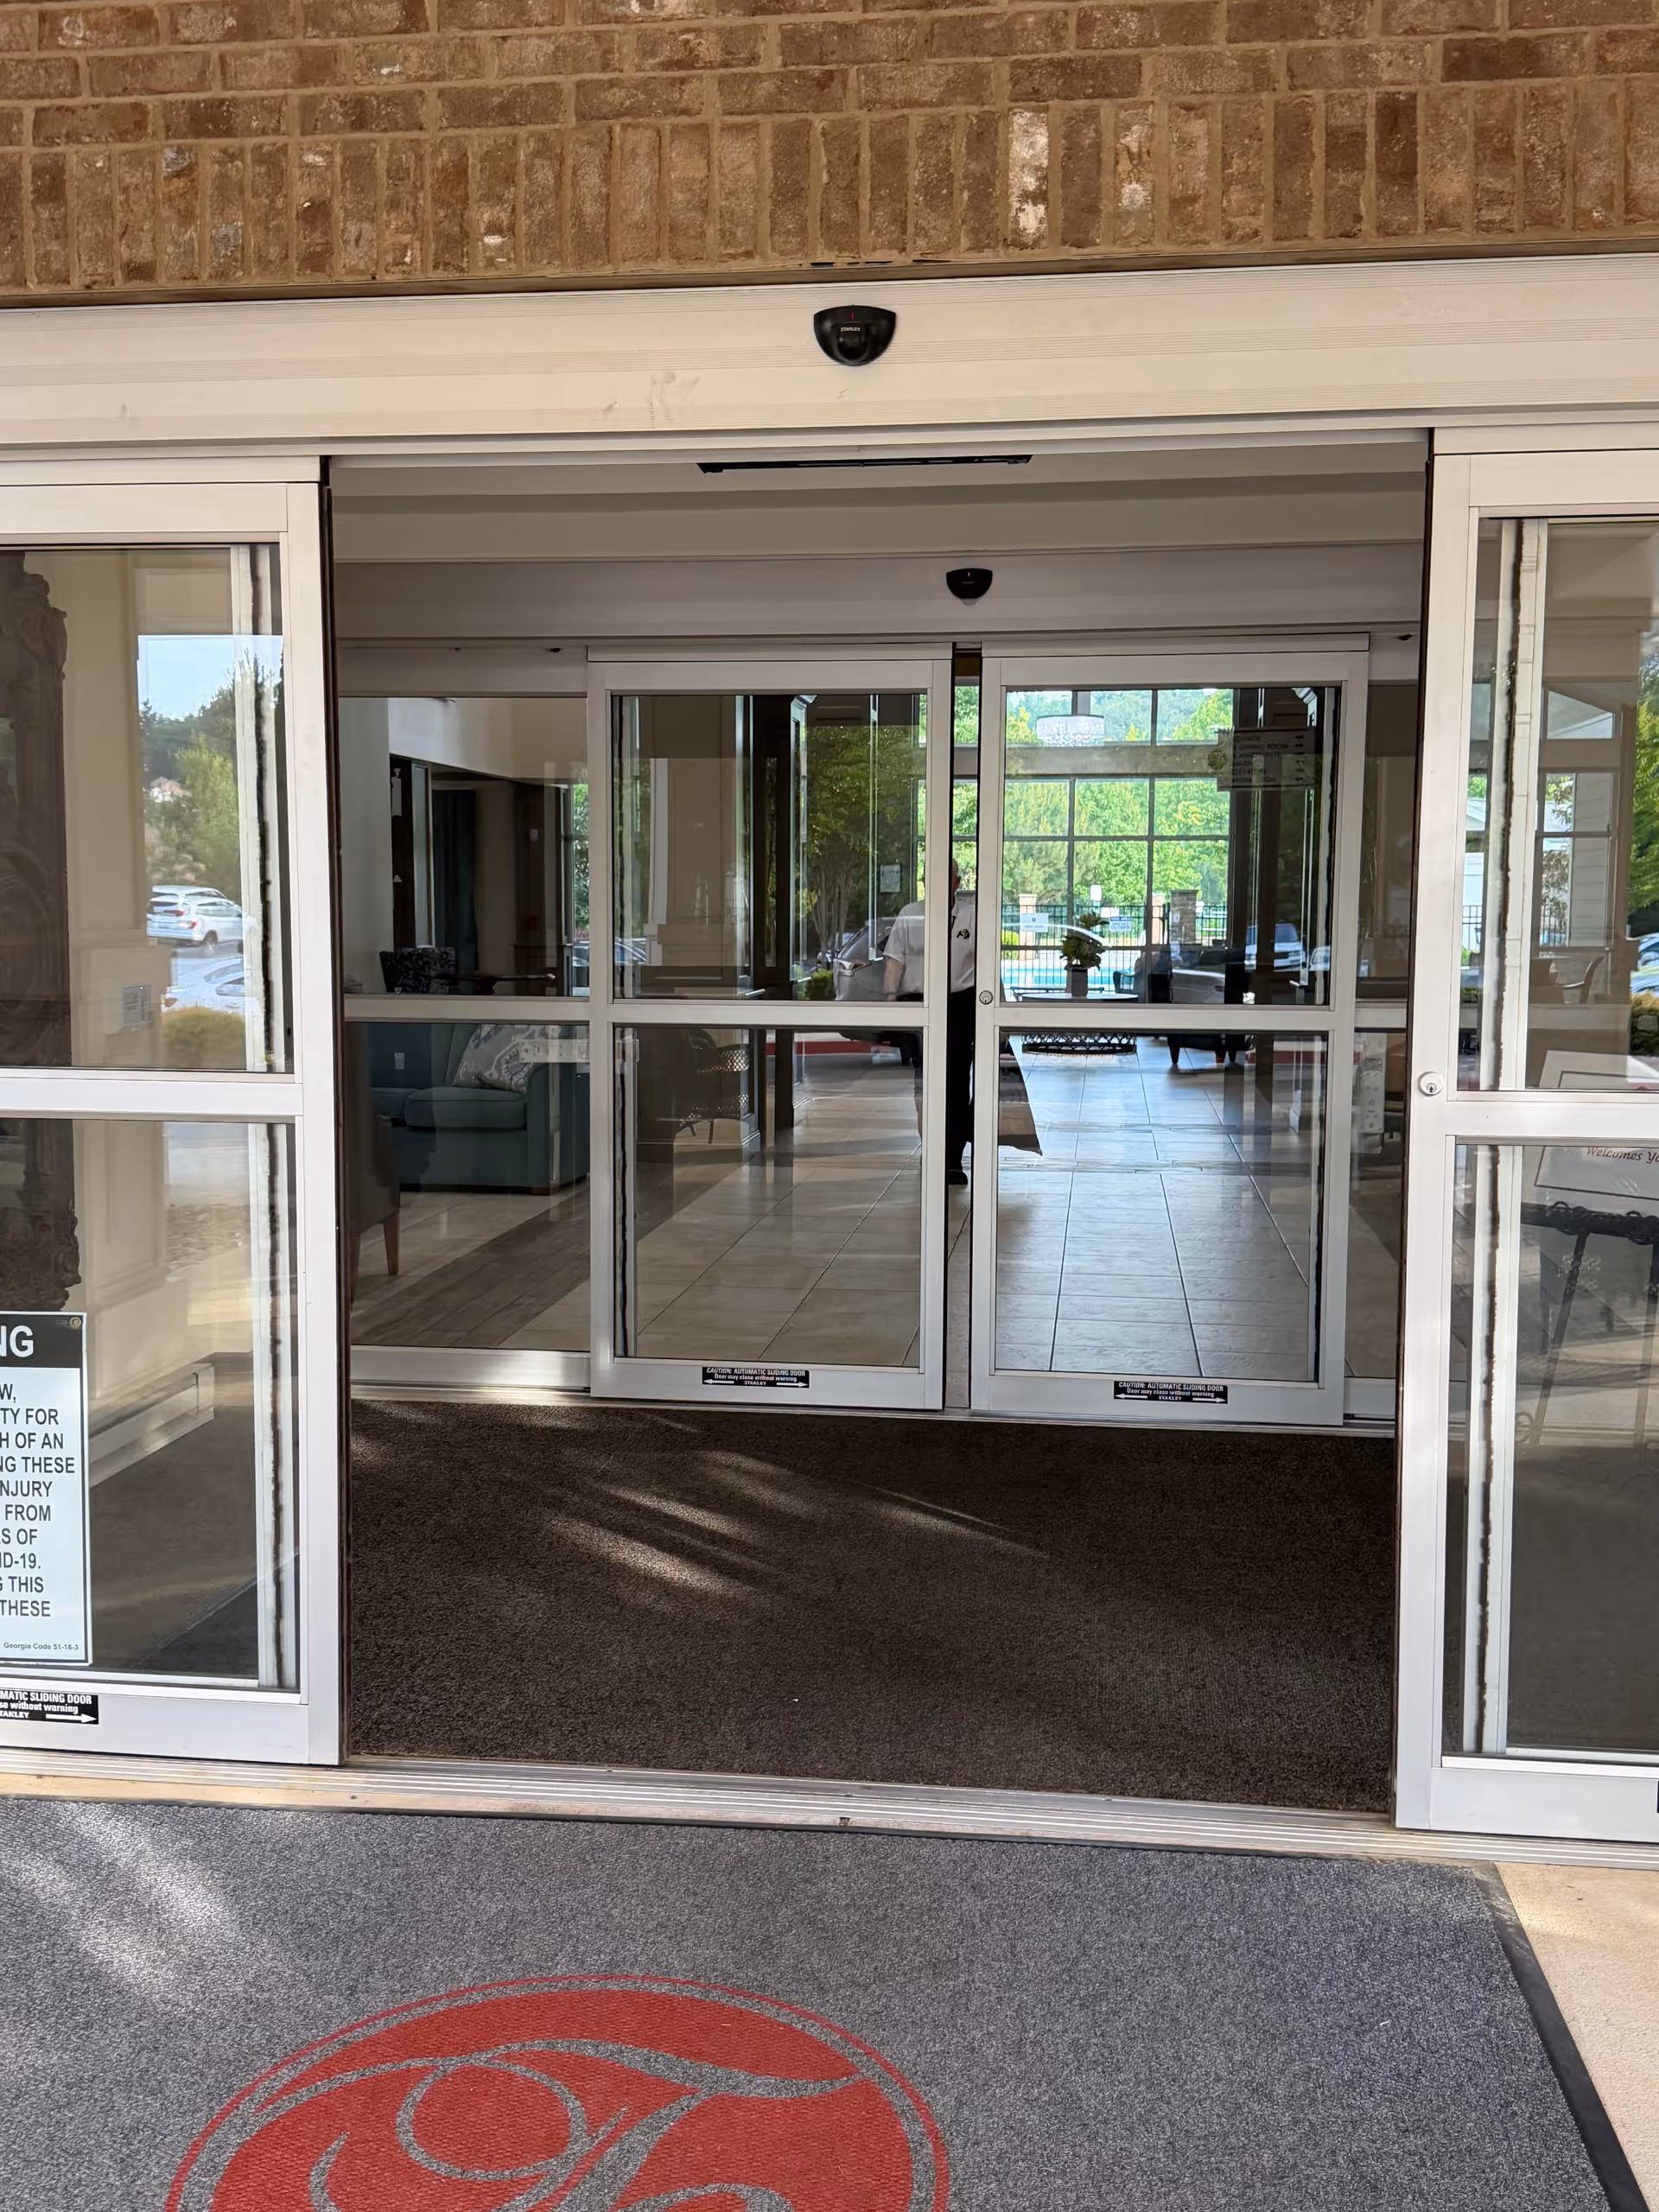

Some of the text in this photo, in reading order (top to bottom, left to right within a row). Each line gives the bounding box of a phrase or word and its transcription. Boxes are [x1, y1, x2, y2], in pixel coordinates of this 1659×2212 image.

[1587, 1147, 1643, 1160] Welcomes
[0, 1325, 34, 1357] G
[0, 1408, 59, 1425] TY FOR
[15, 1432, 36, 1449] OF
[41, 1433, 64, 1449] AN
[22, 1457, 75, 1473] THESE
[0, 1480, 53, 1497] NJURY
[5, 1504, 51, 1521] FROM
[16, 1529, 38, 1545] OF
[8, 1576, 44, 1593] THIS
[0, 1600, 51, 1617] THESE
[3, 1642, 31, 1650] Georgia
[29, 1692, 66, 1703] SLIDING
[67, 1694, 92, 1705] DOOR
[10, 1700, 42, 1711] without
[43, 1703, 79, 1715] warning
